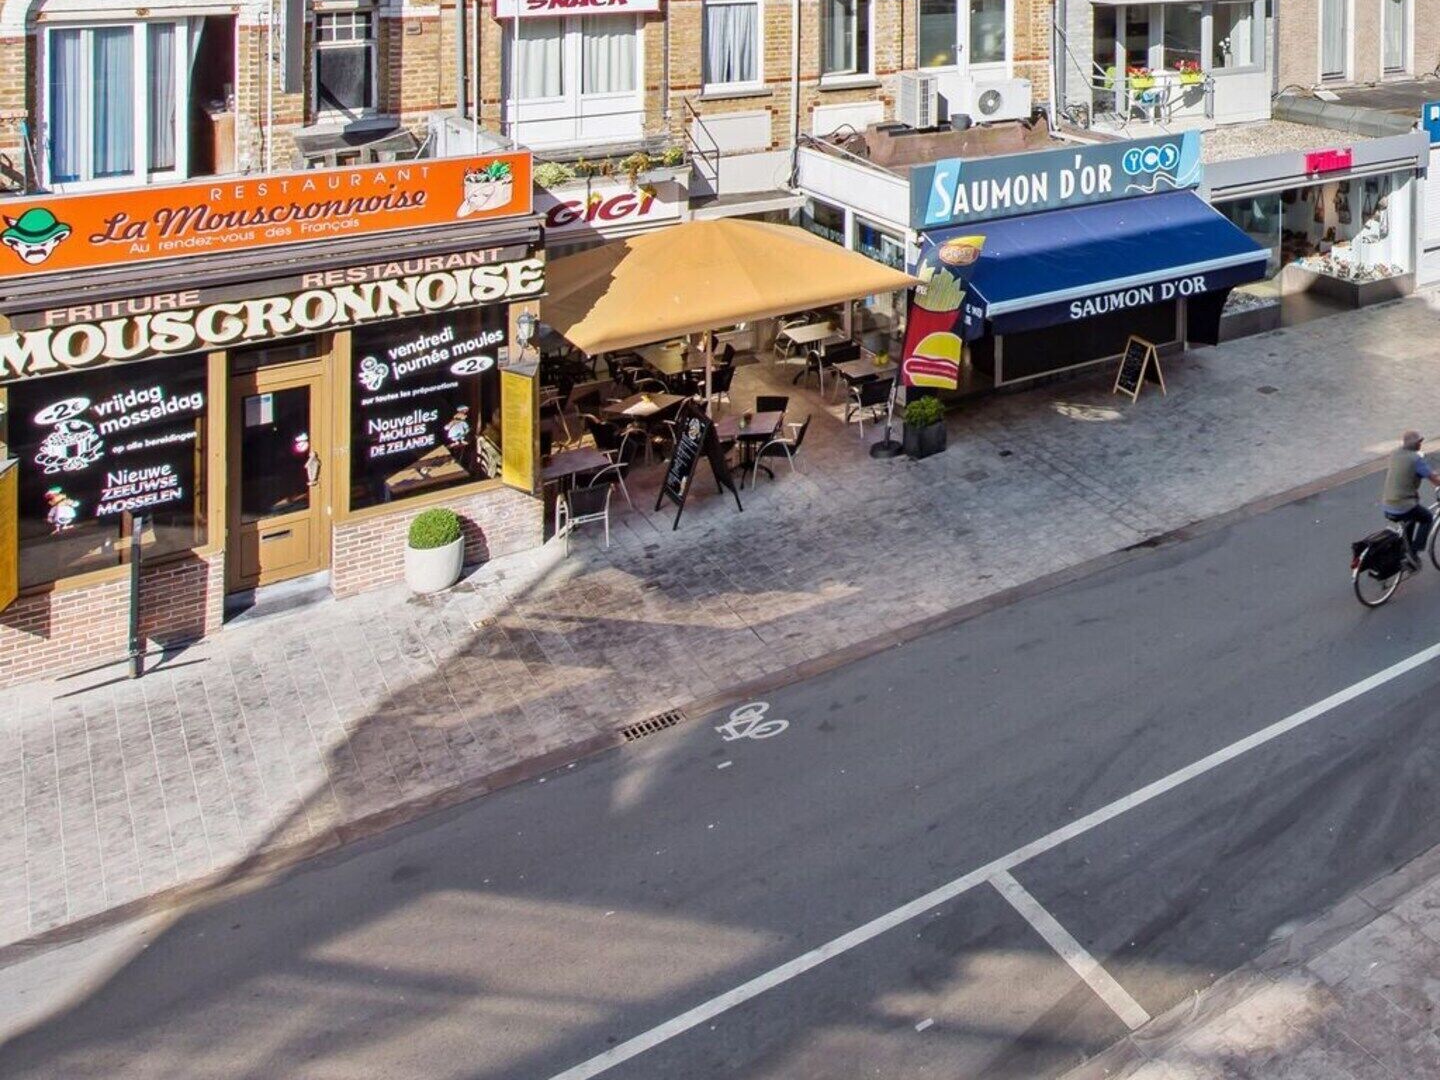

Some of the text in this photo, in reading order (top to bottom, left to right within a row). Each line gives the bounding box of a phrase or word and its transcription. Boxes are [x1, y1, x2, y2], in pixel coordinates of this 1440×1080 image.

[210, 166, 430, 201] RESTAURANT
[934, 154, 1113, 218] SAUMON D'OR
[88, 183, 429, 246] La Mouscronnoise
[545, 191, 657, 228] GIGI
[129, 217, 360, 255] Au rendez-vous des Français
[44, 247, 504, 325] FRITURE RESTAURANT
[1069, 275, 1208, 320] SAUMON D'OR
[388, 325, 454, 360] vendredi
[391, 329, 504, 380] journée moules
[94, 385, 163, 417] vrijdag
[99, 391, 204, 435] mosseldag
[361, 397, 375, 407] sur
[368, 408, 439, 435] Nouvelles
[378, 423, 427, 443] MOULES
[111, 444, 124, 454] op
[370, 434, 436, 458] DE ZELANDE
[101, 474, 178, 502] ZEEUWSE
[107, 463, 172, 488] Nieuwe
[95, 487, 183, 517] MOSSELEN
